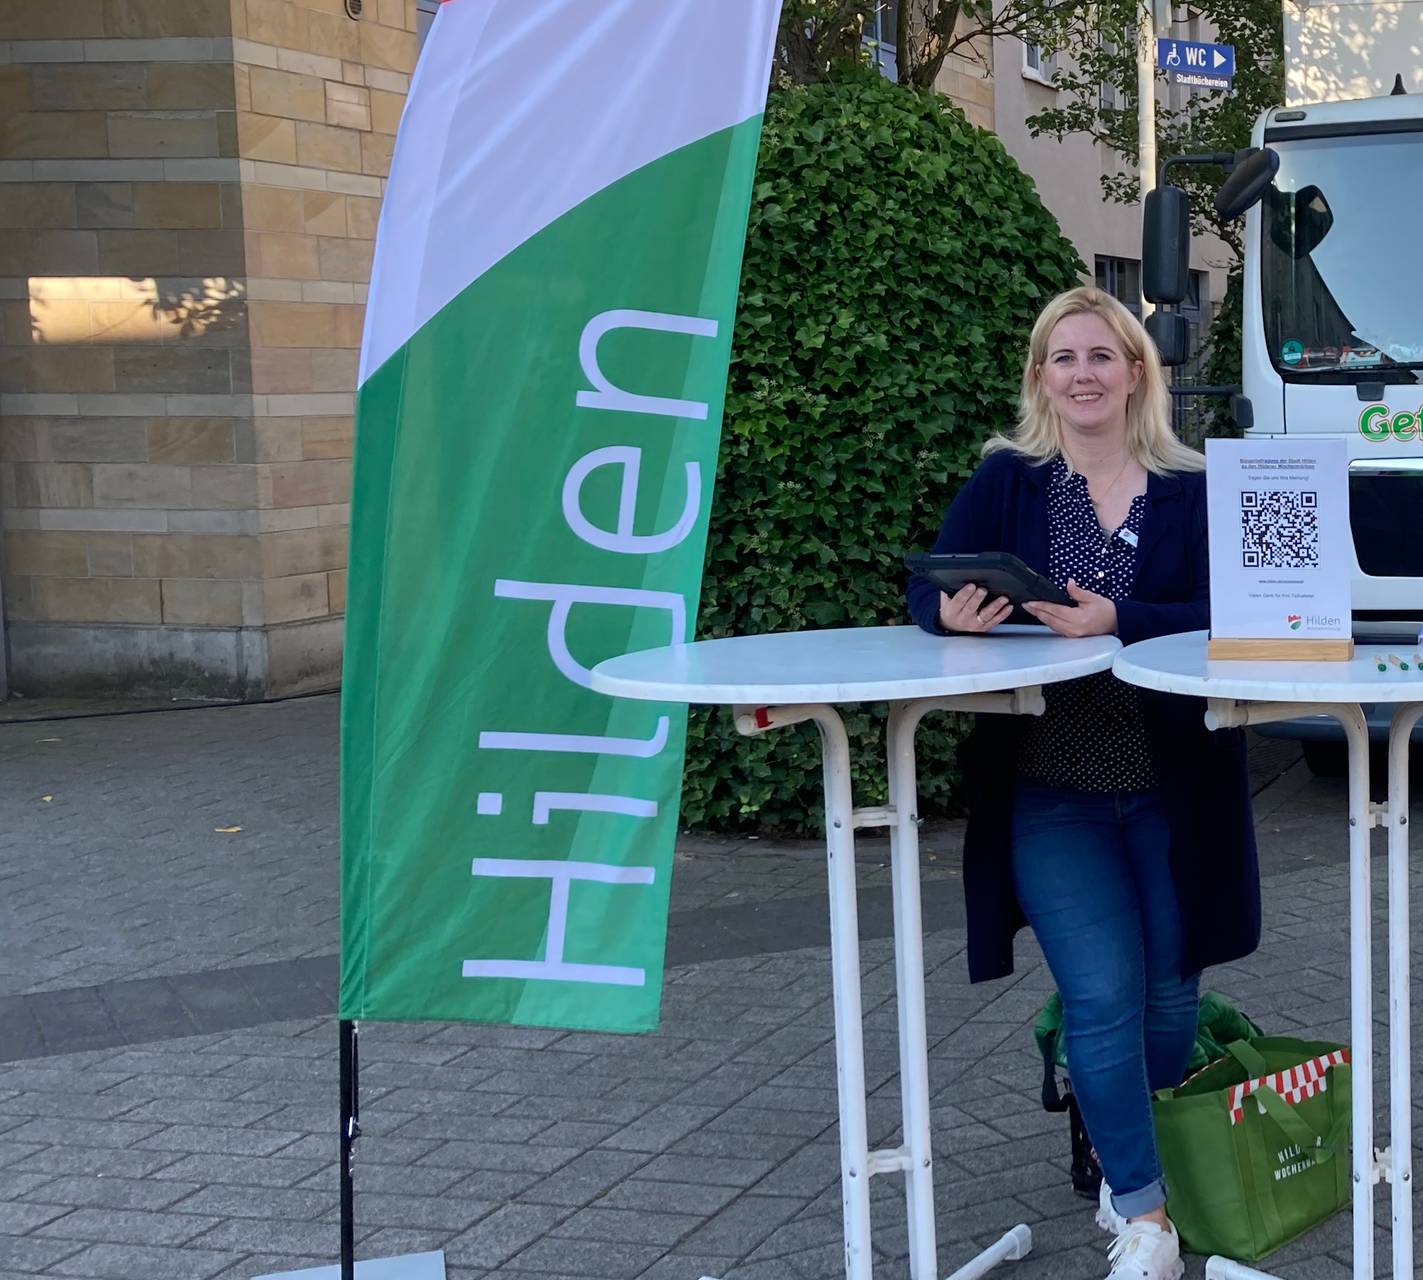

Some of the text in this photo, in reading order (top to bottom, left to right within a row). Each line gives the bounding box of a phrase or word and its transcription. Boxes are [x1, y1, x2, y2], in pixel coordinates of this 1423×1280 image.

[1185, 46, 1207, 67] WC
[1306, 615, 1341, 626] Hilden
[462, 309, 719, 986] Hilden
[1277, 1135, 1322, 1164] HILDR
